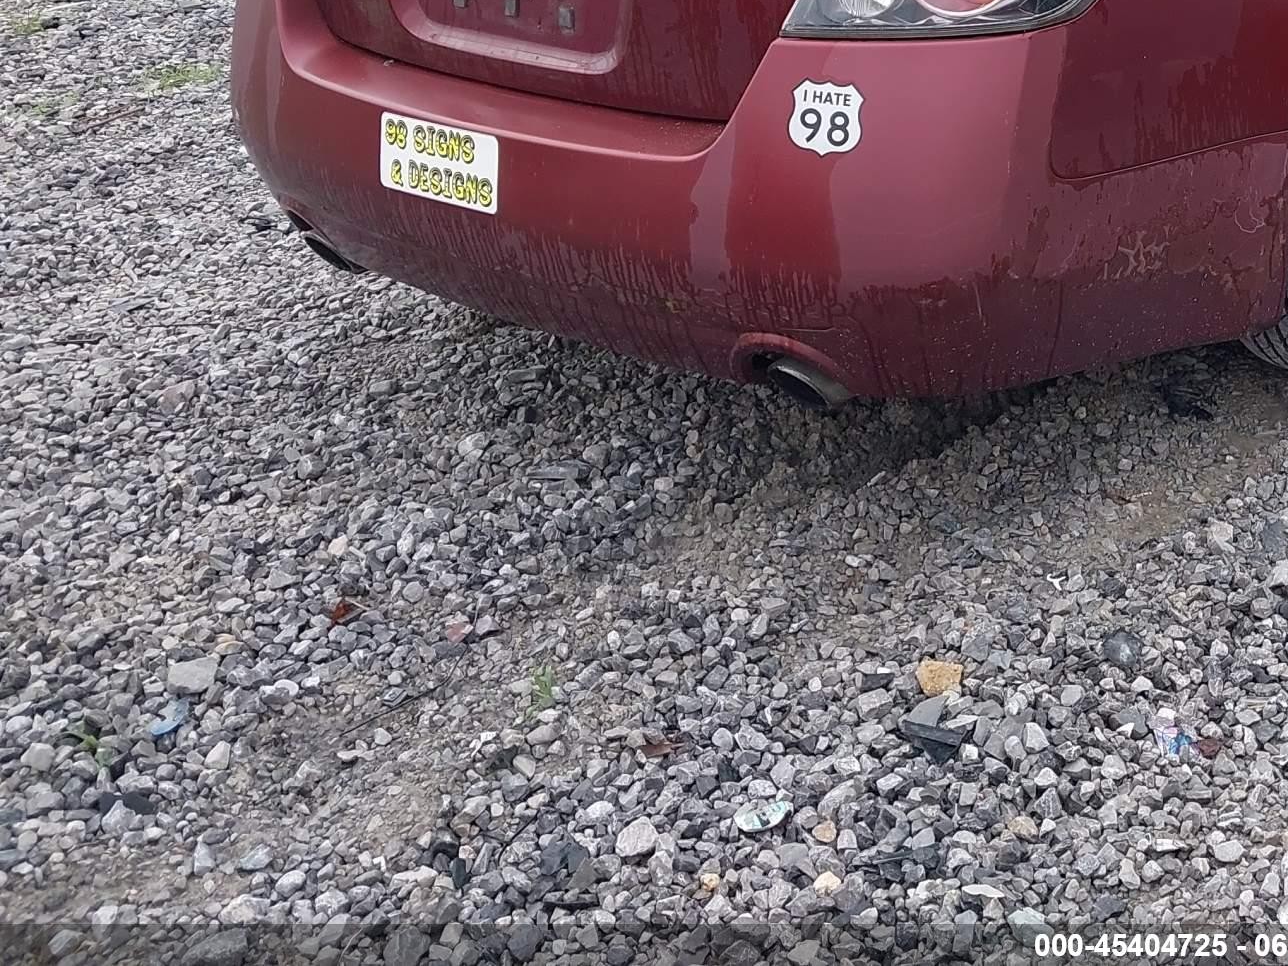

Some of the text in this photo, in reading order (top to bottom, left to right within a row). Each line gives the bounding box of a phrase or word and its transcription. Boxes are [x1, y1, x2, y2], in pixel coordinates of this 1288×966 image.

[813, 90, 852, 107] HATE
[385, 118, 475, 164] 98 SIGNS
[799, 108, 850, 147] 98
[390, 159, 493, 208] & DESIGNS
